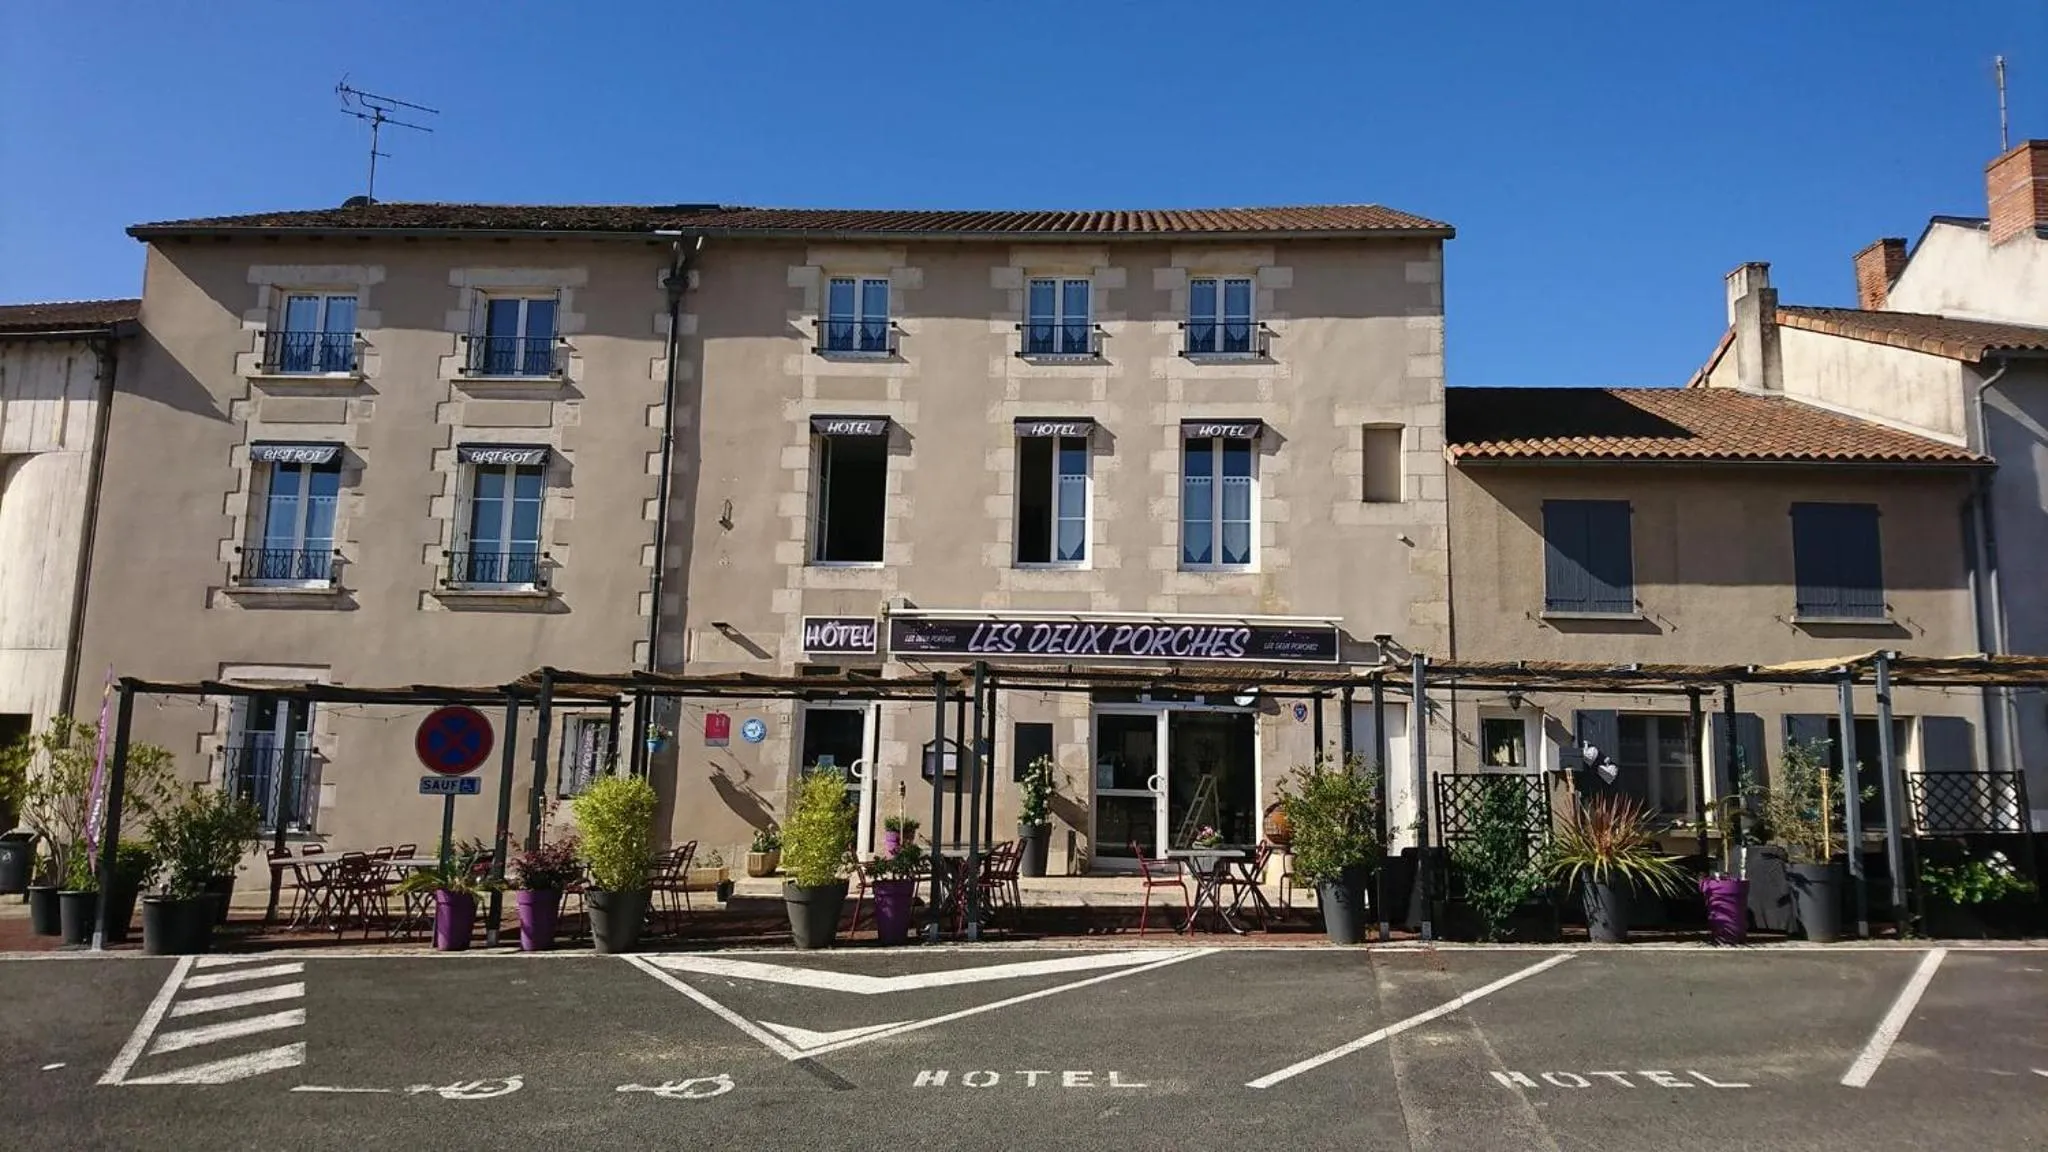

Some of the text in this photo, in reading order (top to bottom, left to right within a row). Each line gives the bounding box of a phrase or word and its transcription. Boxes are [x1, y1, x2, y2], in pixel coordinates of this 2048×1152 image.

[827, 422, 872, 434] HOTEL
[1031, 424, 1077, 436] HOTEL
[1199, 425, 1245, 437] HOTEL
[263, 448, 325, 462] BISTROT
[471, 451, 532, 463] BISTROT
[805, 621, 875, 648] HÔTEL
[967, 623, 1251, 658] LES DEUX PORCHES
[423, 779, 458, 791] SAUF
[913, 1070, 1149, 1088] HOTEL
[1489, 1070, 1752, 1089] HOTEL
